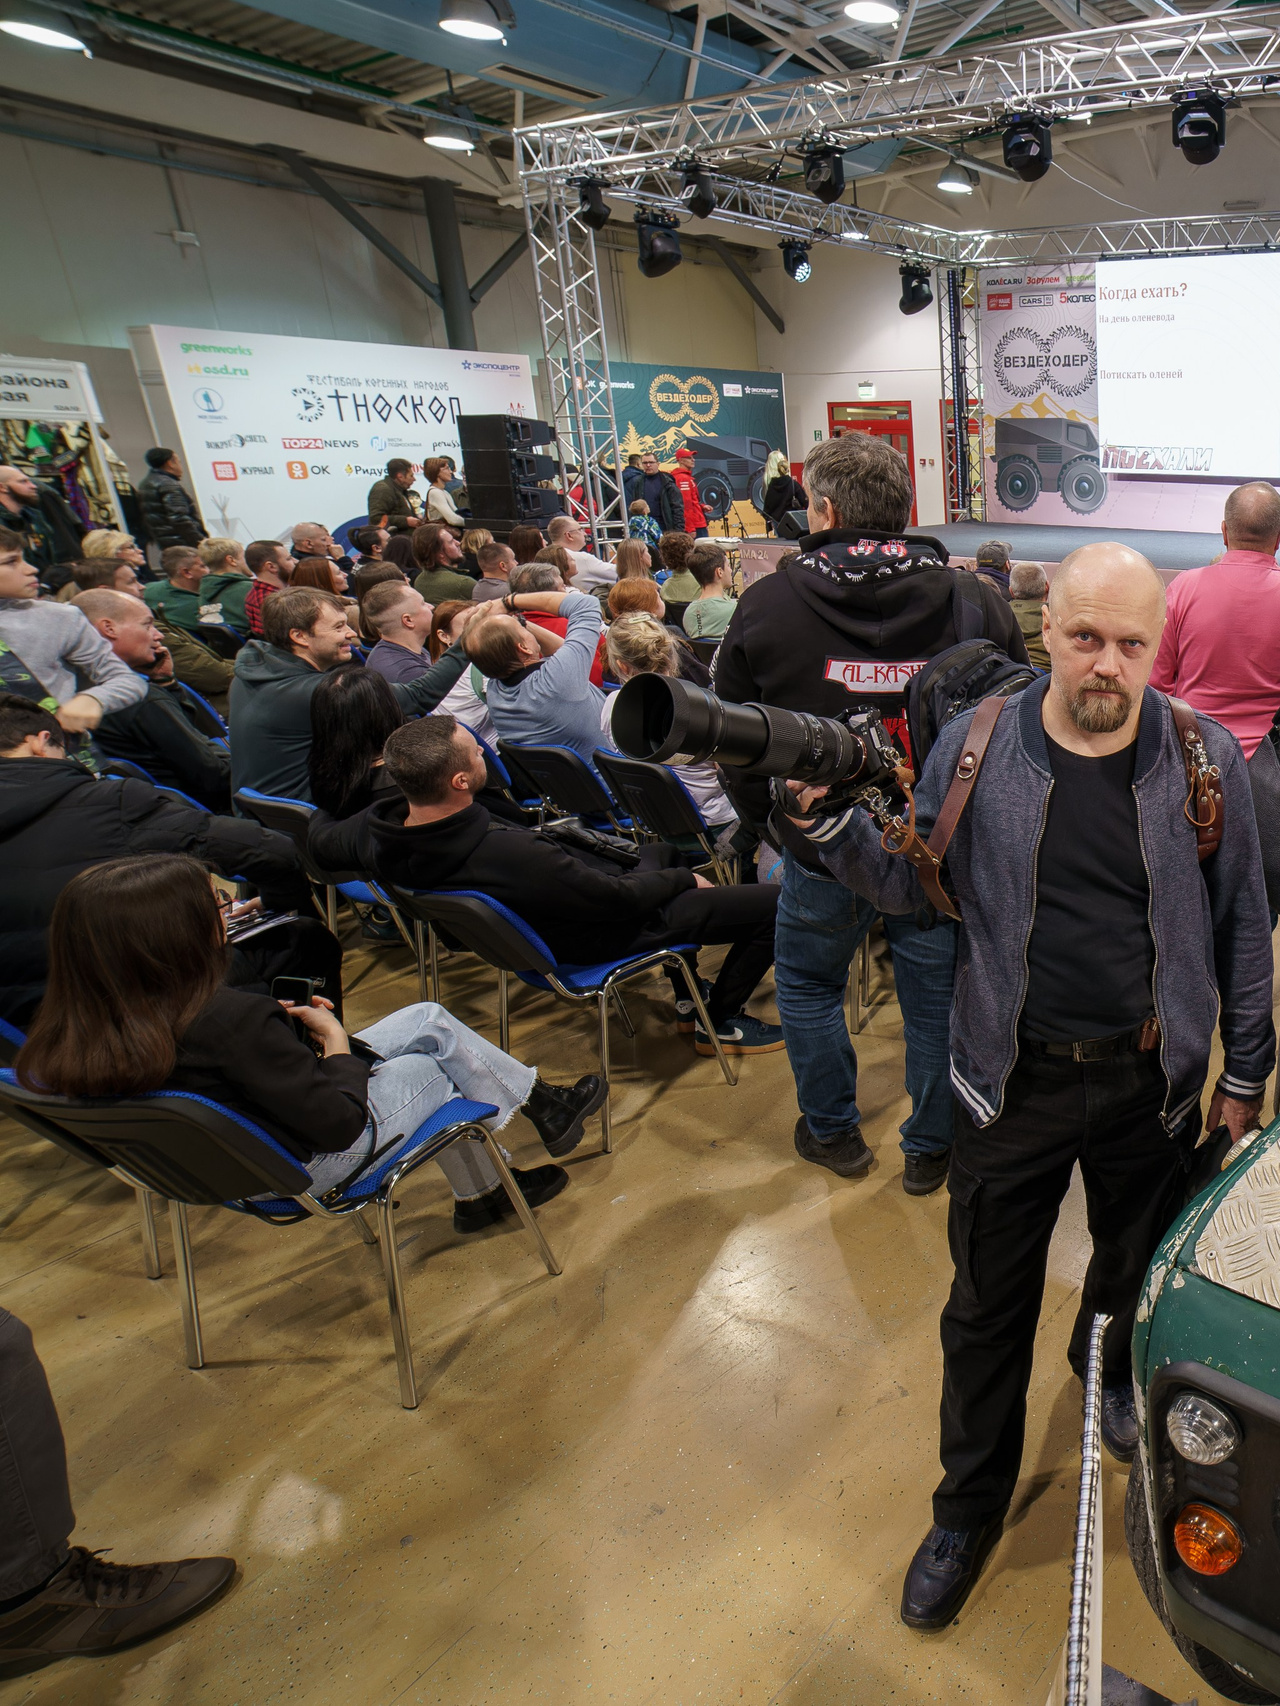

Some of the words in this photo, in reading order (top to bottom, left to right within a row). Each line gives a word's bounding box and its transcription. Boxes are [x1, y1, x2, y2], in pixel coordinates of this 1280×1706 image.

[1099, 286, 1137, 302] Когда
[1141, 282, 1188, 299] ехать?
[1022, 297, 1042, 305] CARS
[1099, 314, 1109, 323] На
[1111, 315, 1130, 324] день
[1132, 313, 1175, 323] оленевода
[473, 362, 520, 371] ЭКСПОЦЕНТР
[1003, 353, 1089, 370] ВЕЗДЕХОДЕР
[1100, 369, 1147, 380] Потискать
[1149, 368, 1183, 379] оленей
[0, 372, 70, 389] айона
[0, 391, 30, 402] ая
[656, 392, 713, 403] ВЕЗДЕХОДЕР
[282, 439, 323, 448] TOP24
[324, 440, 359, 448] NEWS
